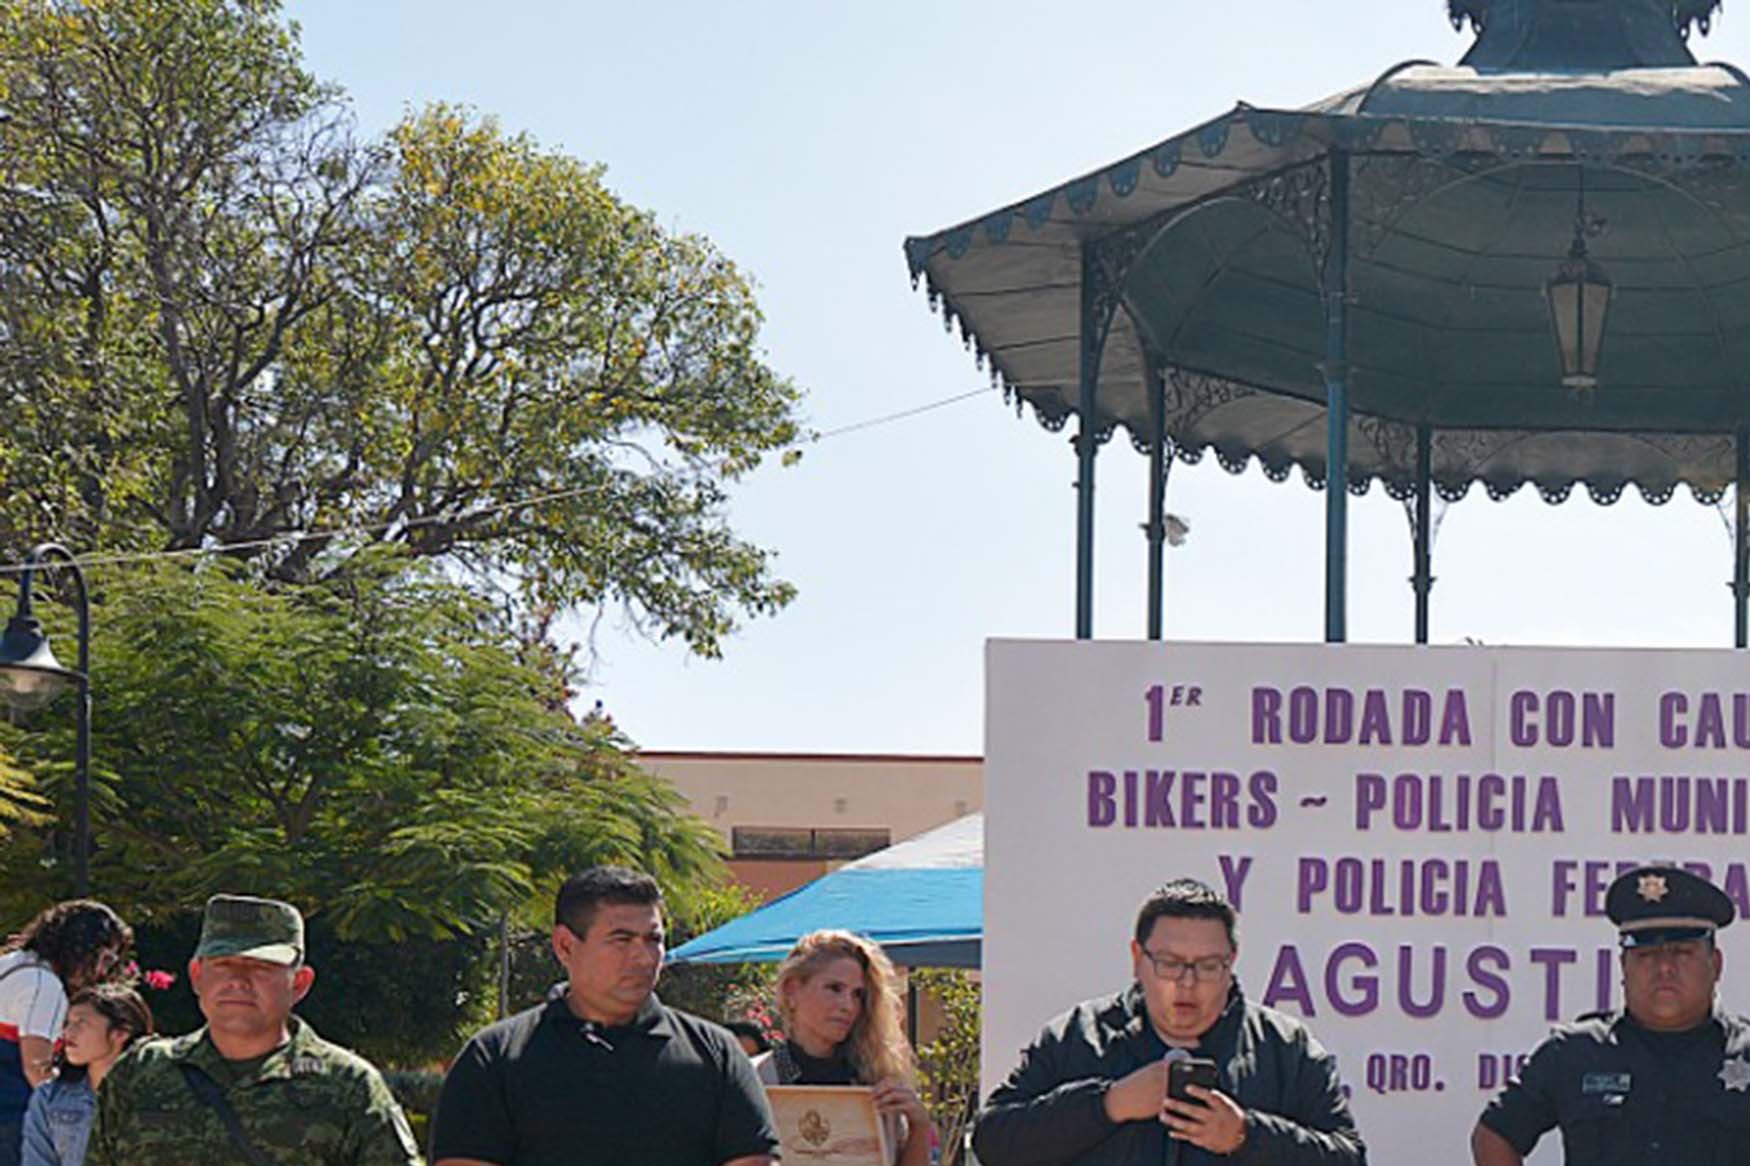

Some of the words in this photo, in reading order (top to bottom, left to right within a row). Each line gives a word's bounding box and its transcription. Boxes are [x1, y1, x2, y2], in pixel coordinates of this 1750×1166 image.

[1252, 687, 1472, 746] RODADA
[1511, 690, 1615, 748] CON
[1087, 769, 1278, 830] BIKERS
[1357, 774, 1564, 834] POLICIA
[1219, 855, 1254, 912] Y
[1298, 856, 1506, 919] POLICIA
[1366, 1053, 1445, 1094] QRO.
